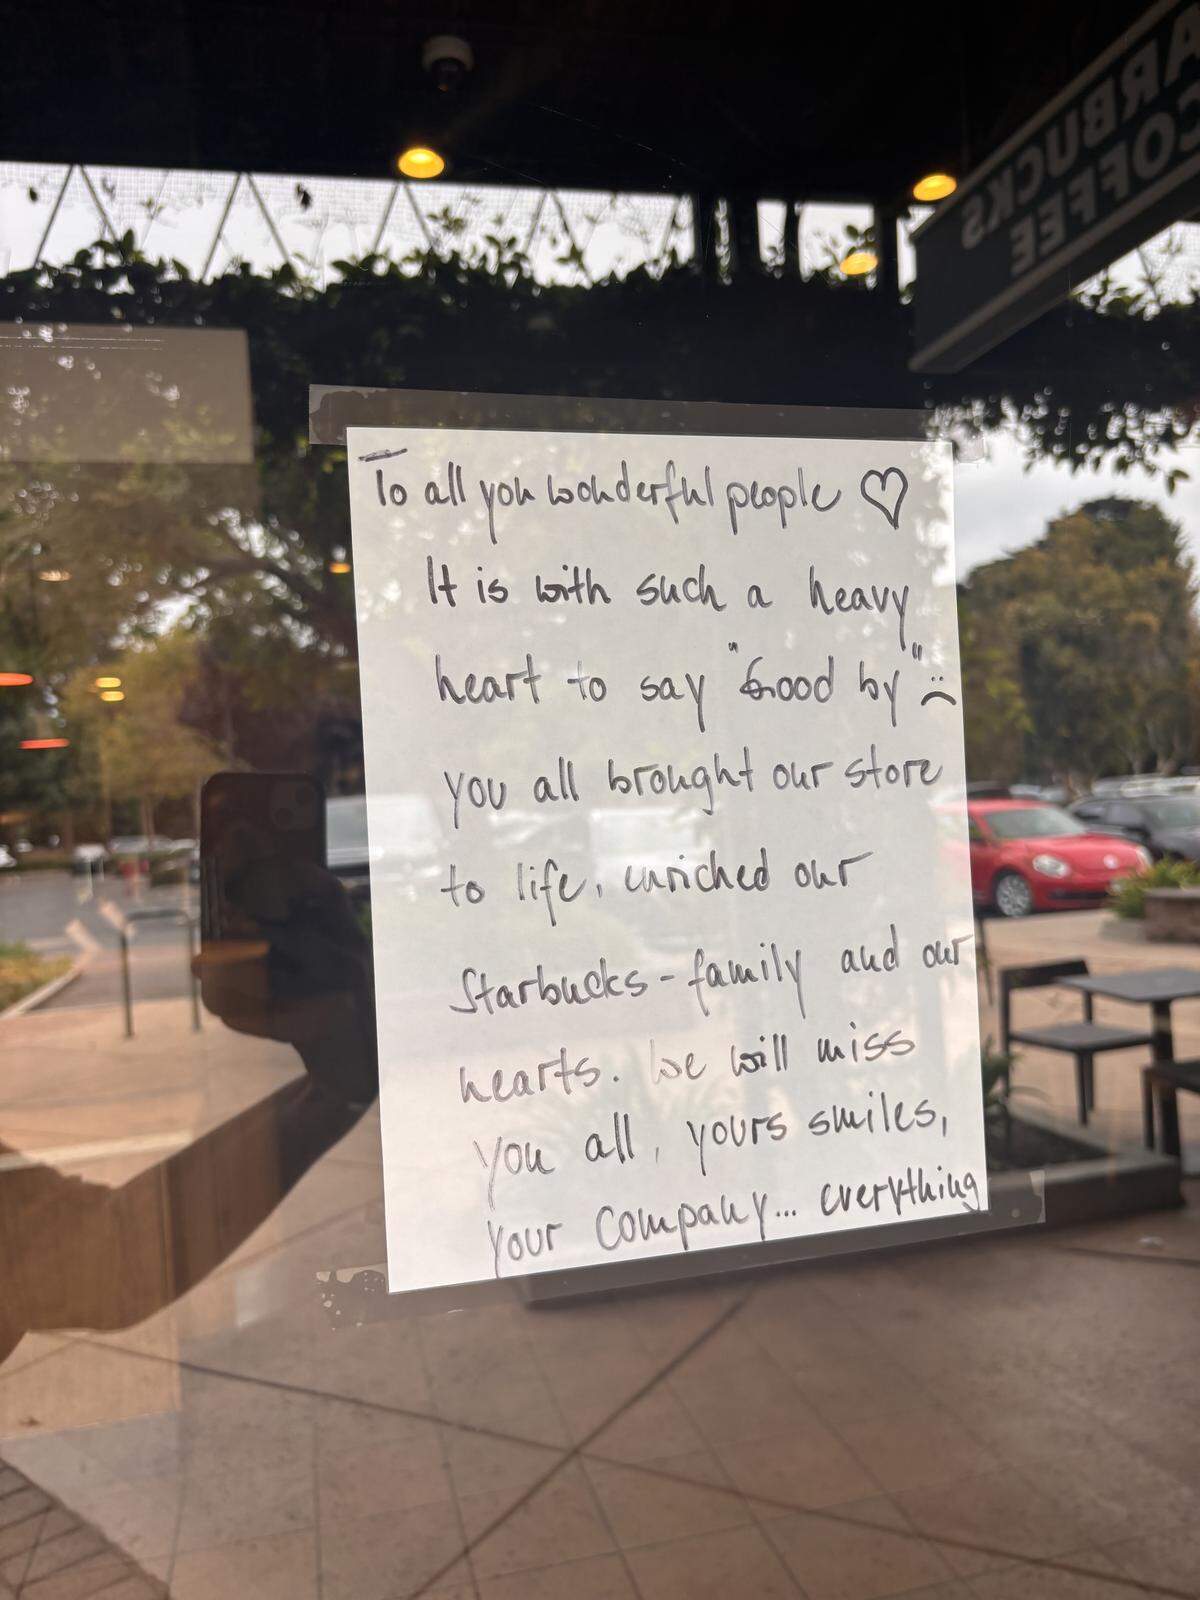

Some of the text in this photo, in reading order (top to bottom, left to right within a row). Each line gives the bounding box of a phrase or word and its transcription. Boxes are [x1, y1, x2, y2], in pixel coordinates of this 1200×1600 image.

[359, 448, 842, 545] To all you wonderful people
[426, 554, 910, 652] It is with such a heavy
[434, 653, 542, 706] heart
[567, 660, 607, 701] to
[639, 671, 707, 733] say
[532, 755, 580, 805] all
[607, 745, 756, 816] brought
[771, 759, 834, 793] our
[843, 743, 944, 786] store
[440, 864, 485, 907] to
[624, 847, 771, 895] enriched
[794, 850, 874, 889] our
[841, 924, 900, 975] and
[922, 934, 973, 968] our
[460, 1047, 619, 1103] hearts.
[731, 1033, 788, 1078] will
[818, 1022, 916, 1064] miss
[808, 1091, 946, 1136] smiles,
[820, 1165, 980, 1216] everything
